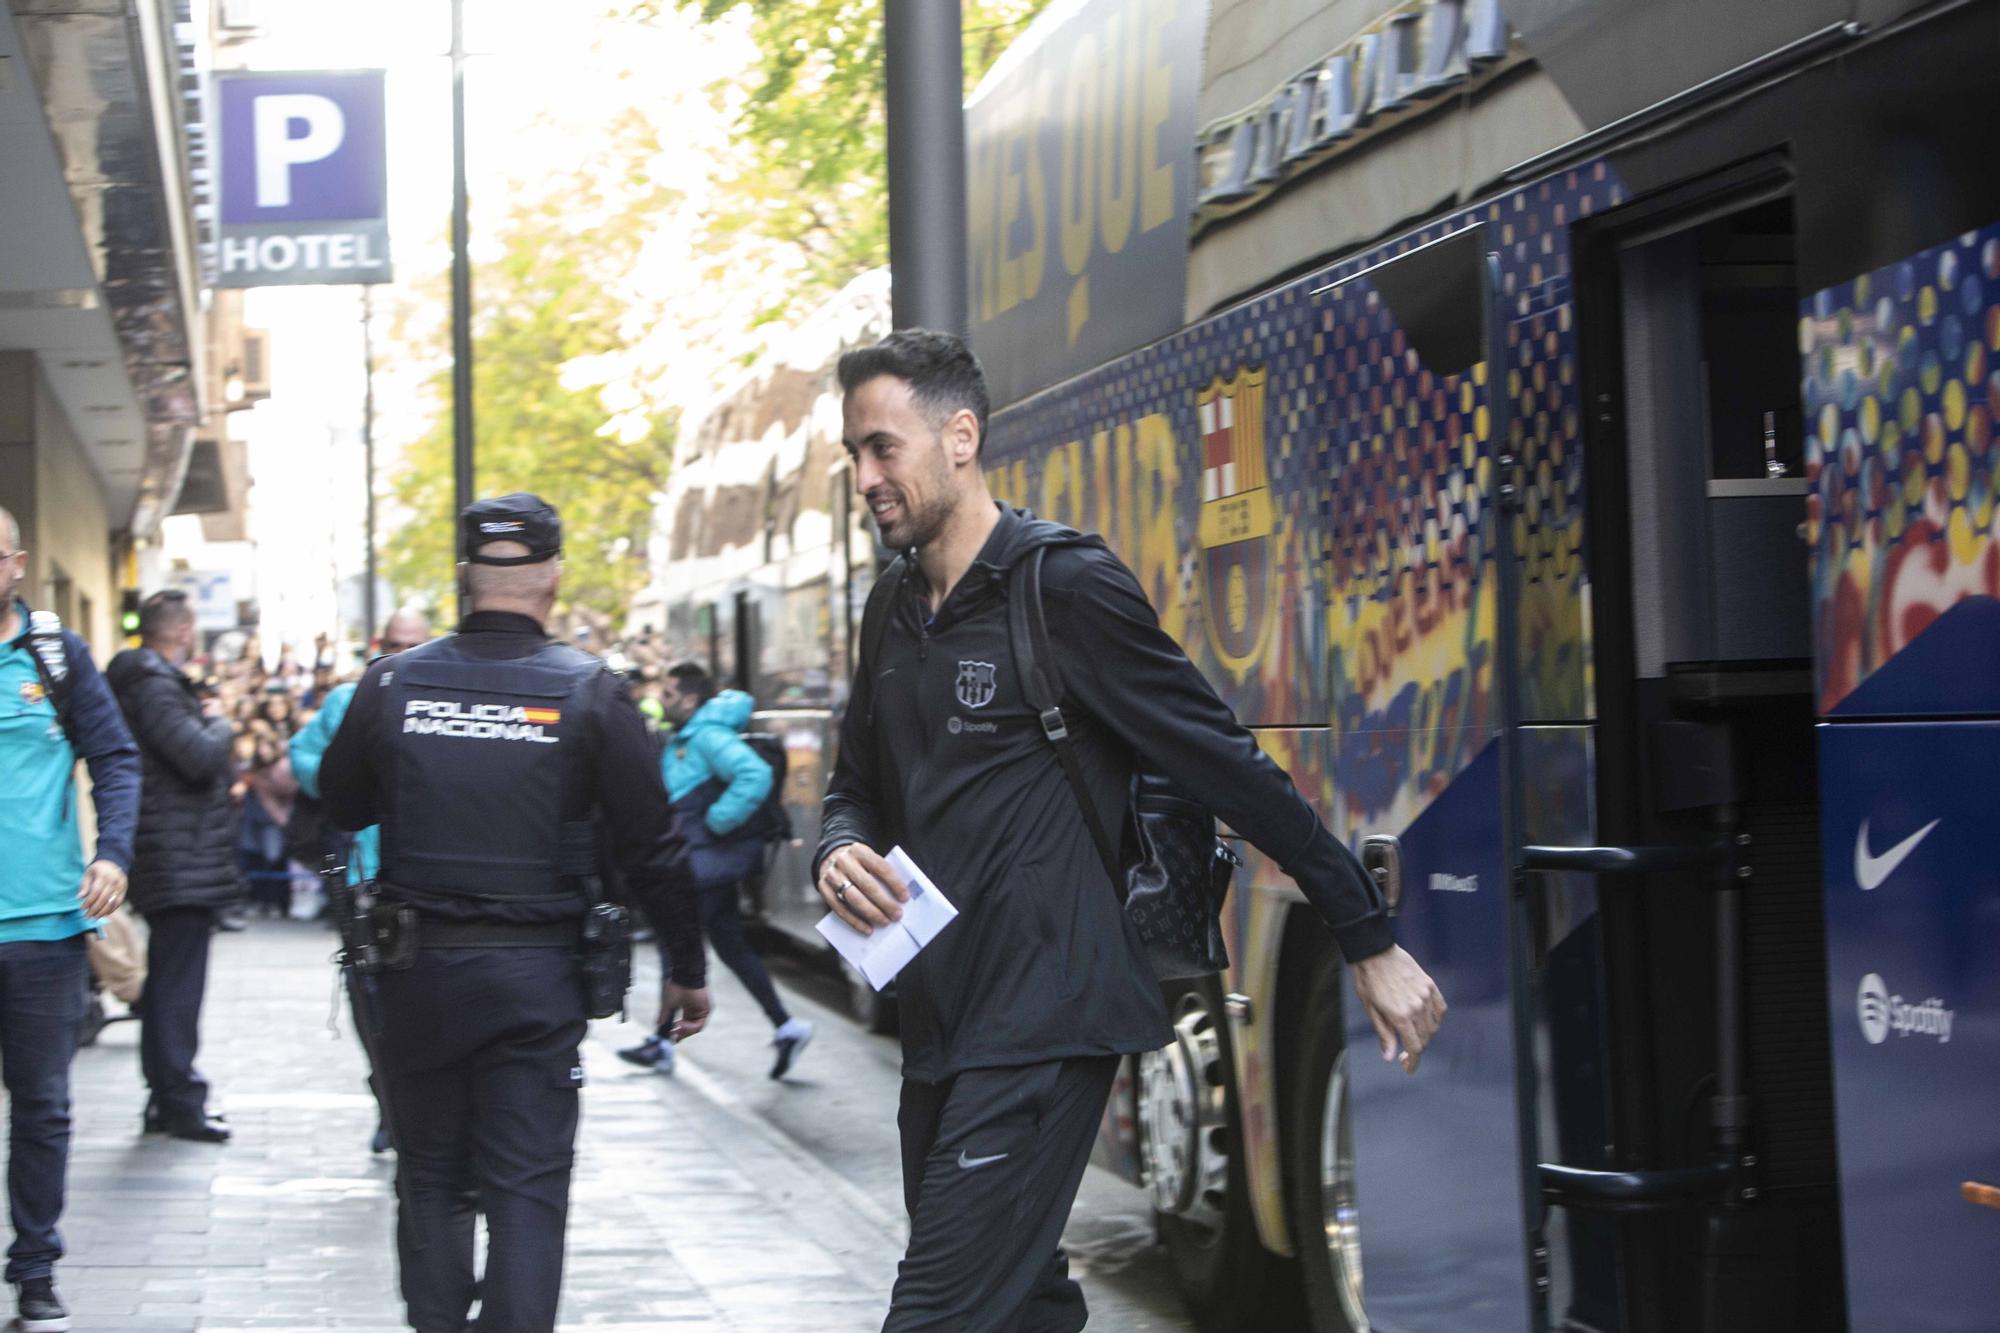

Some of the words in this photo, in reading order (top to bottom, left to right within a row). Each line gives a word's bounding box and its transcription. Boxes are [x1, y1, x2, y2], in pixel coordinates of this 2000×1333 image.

[254, 93, 345, 208] P
[222, 233, 383, 273] HOTEL
[402, 717, 560, 743] NACIONAL
[963, 721, 999, 734] Spotify
[1890, 994, 1954, 1044] Spotify
